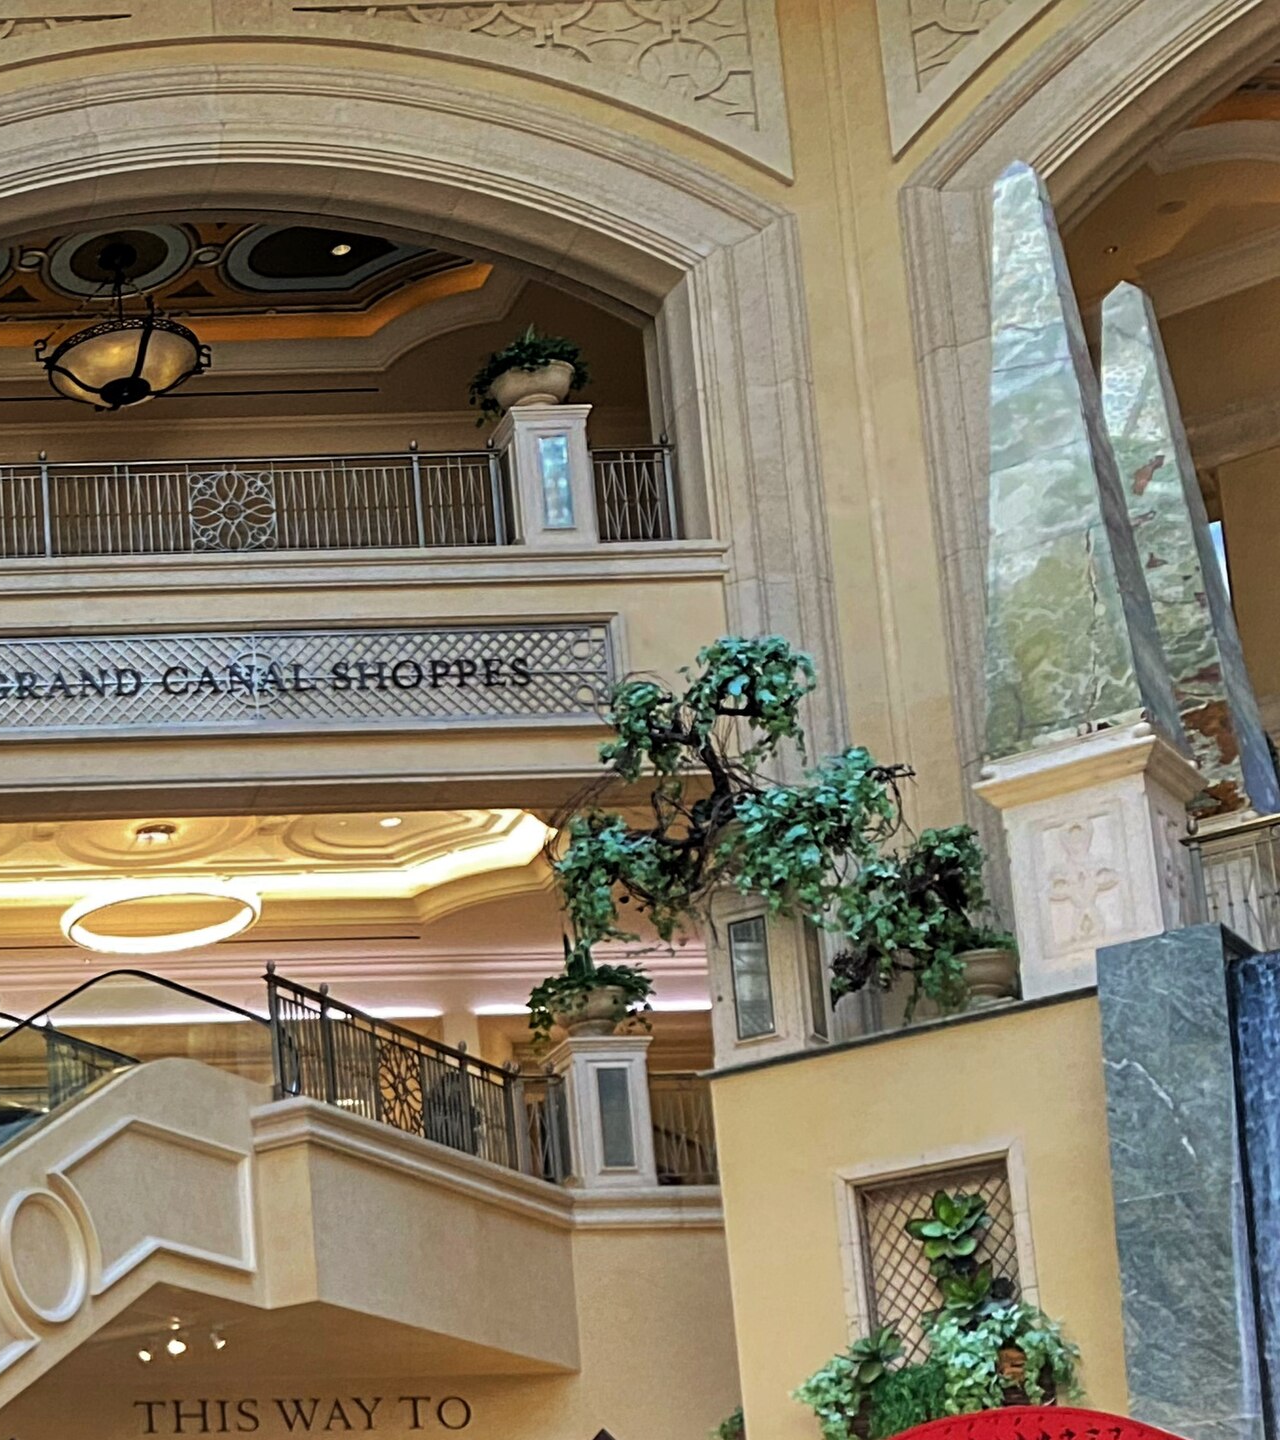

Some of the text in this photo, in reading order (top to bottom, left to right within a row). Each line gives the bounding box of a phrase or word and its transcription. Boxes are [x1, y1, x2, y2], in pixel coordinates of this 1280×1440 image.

[161, 663, 311, 697] CANAL
[332, 656, 534, 692] SHOPPES
[133, 1396, 473, 1434] THIS WAY TO
